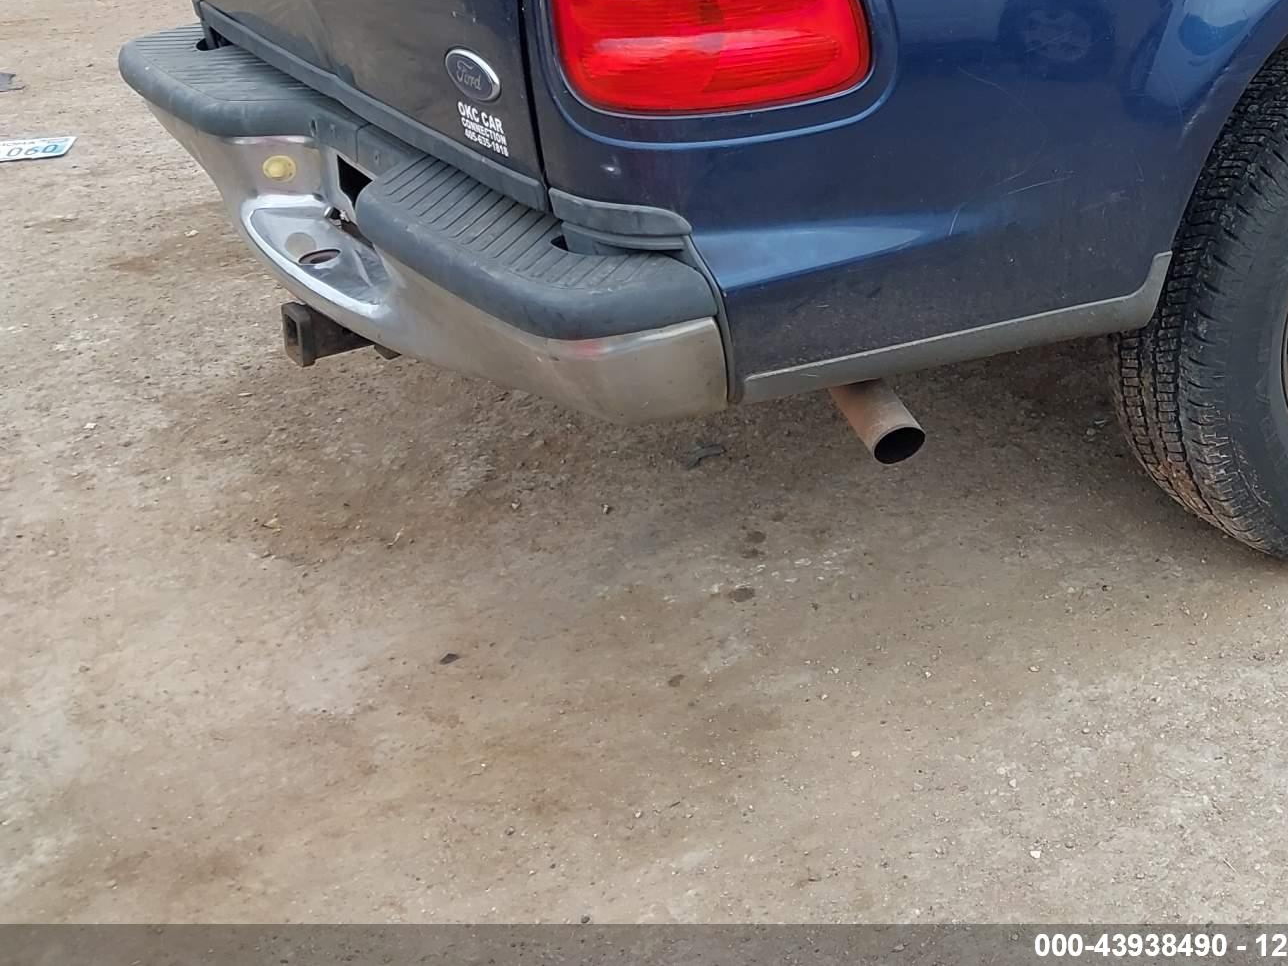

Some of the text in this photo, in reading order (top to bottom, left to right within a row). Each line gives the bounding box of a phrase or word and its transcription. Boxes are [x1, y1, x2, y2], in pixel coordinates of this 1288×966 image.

[456, 60, 482, 91] Ford
[458, 101, 504, 134] OKC CAR
[461, 117, 507, 145] CONNECTION
